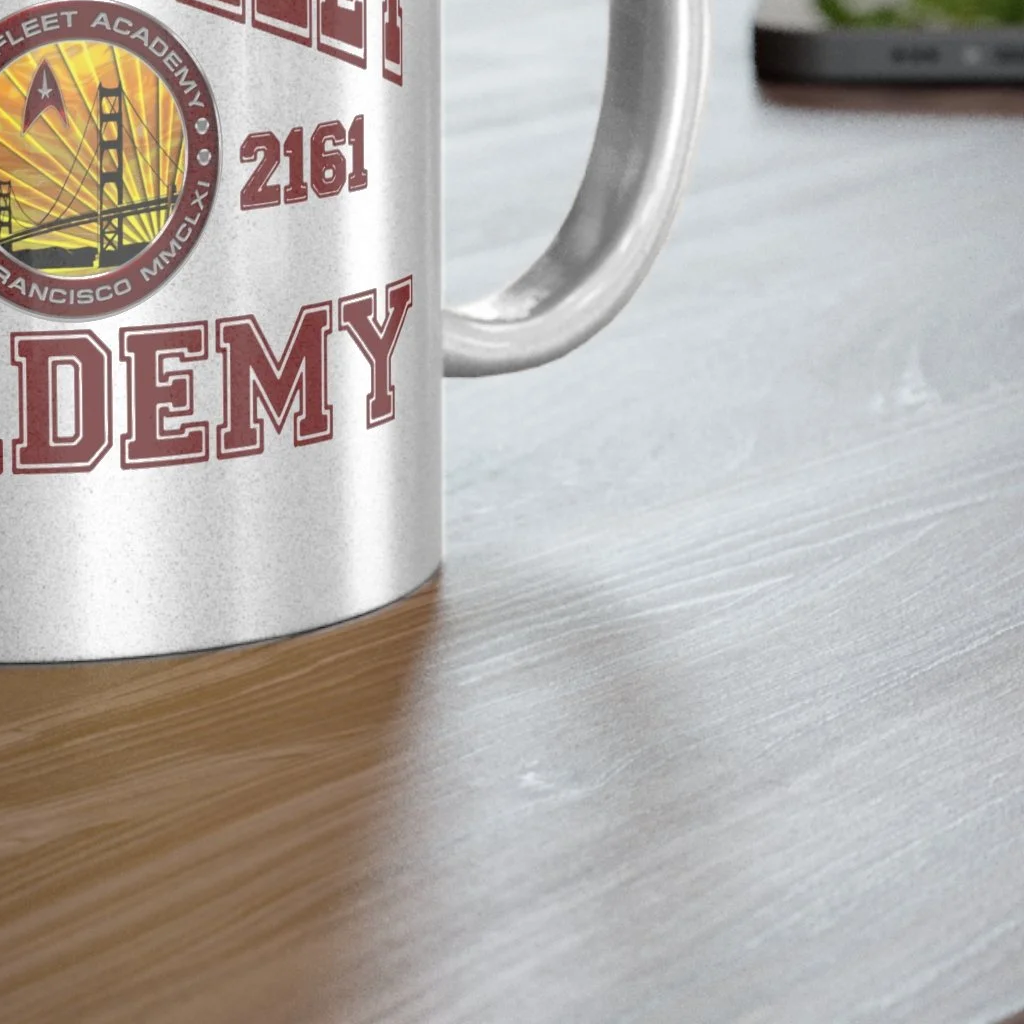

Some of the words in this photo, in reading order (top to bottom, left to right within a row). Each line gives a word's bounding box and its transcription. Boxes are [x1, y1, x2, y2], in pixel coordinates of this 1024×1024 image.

[91, 11, 206, 108] ACADEMY
[240, 115, 368, 210] 2161
[140, 180, 211, 282] MMCLXI
